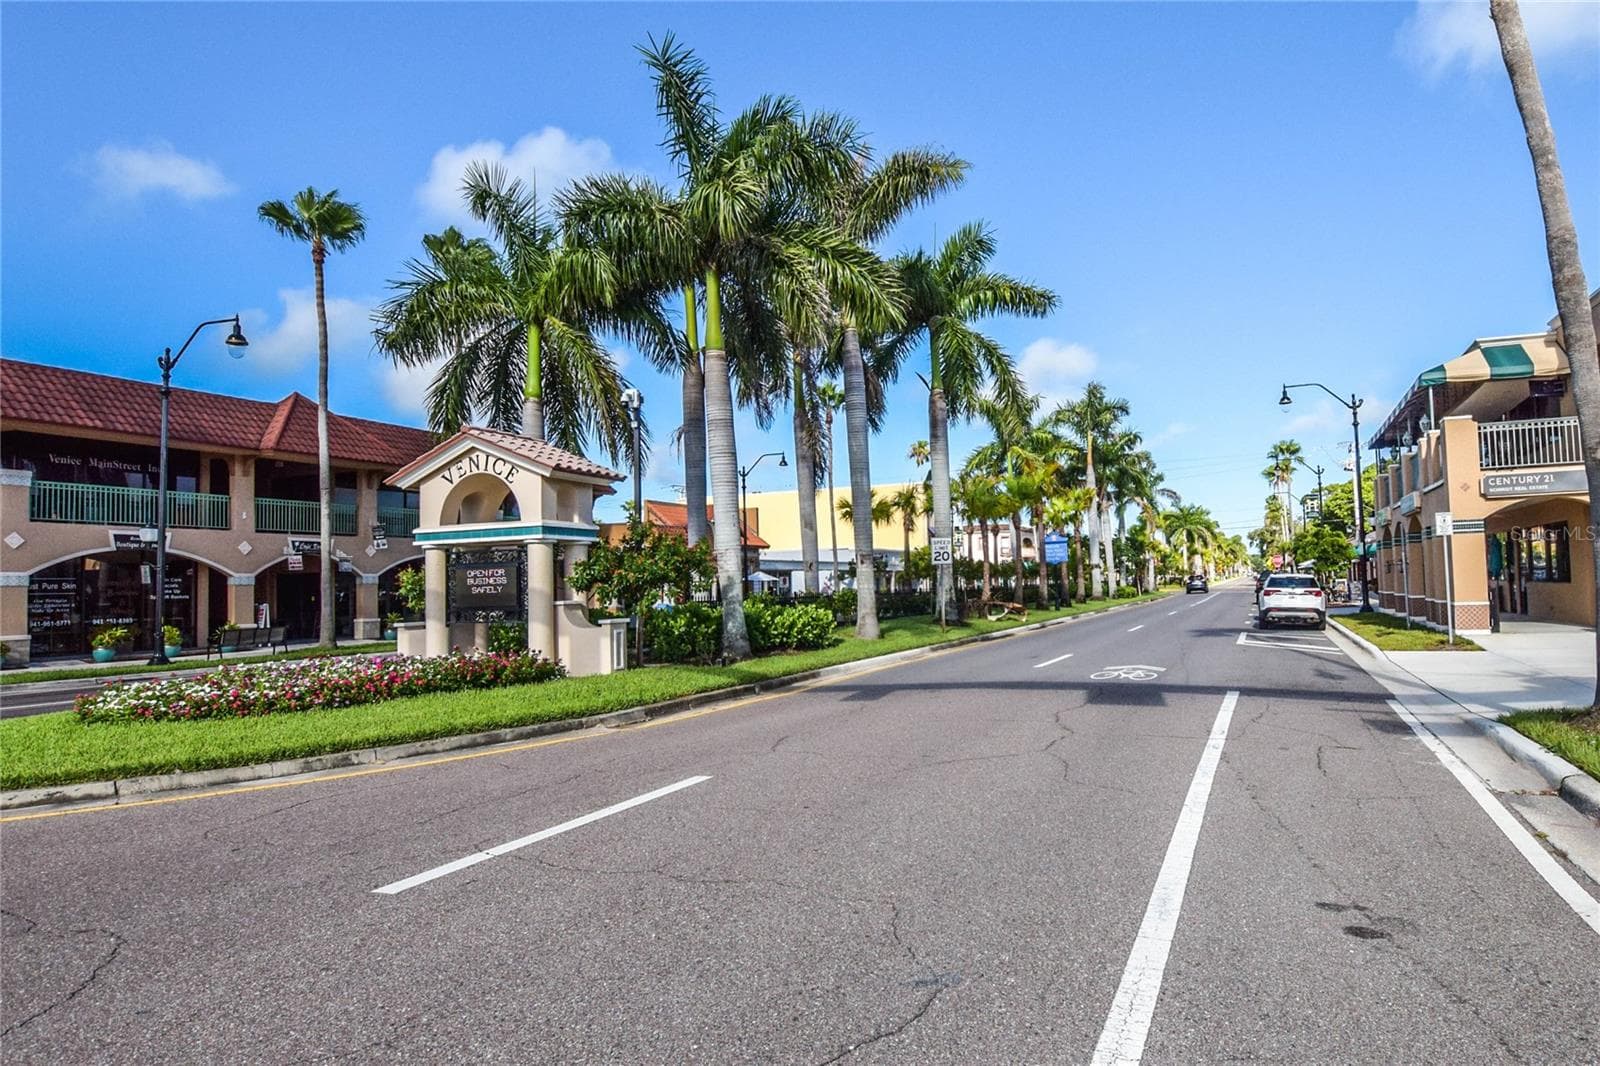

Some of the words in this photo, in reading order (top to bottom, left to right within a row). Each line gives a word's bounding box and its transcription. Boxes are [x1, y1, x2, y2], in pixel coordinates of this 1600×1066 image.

[48, 453, 82, 466] Venice
[88, 457, 142, 472] MainStreet
[441, 454, 519, 484] VENICE
[1488, 475, 1541, 486] CENTURY
[1543, 474, 1555, 483] 21
[934, 551, 950, 561] 20
[466, 569, 488, 577] OPEN
[489, 568, 505, 576] FOR
[467, 577, 507, 585] BUSINESS
[42, 582, 59, 590] Pure
[61, 582, 77, 590] Skin
[471, 585, 503, 594] SAFELY
